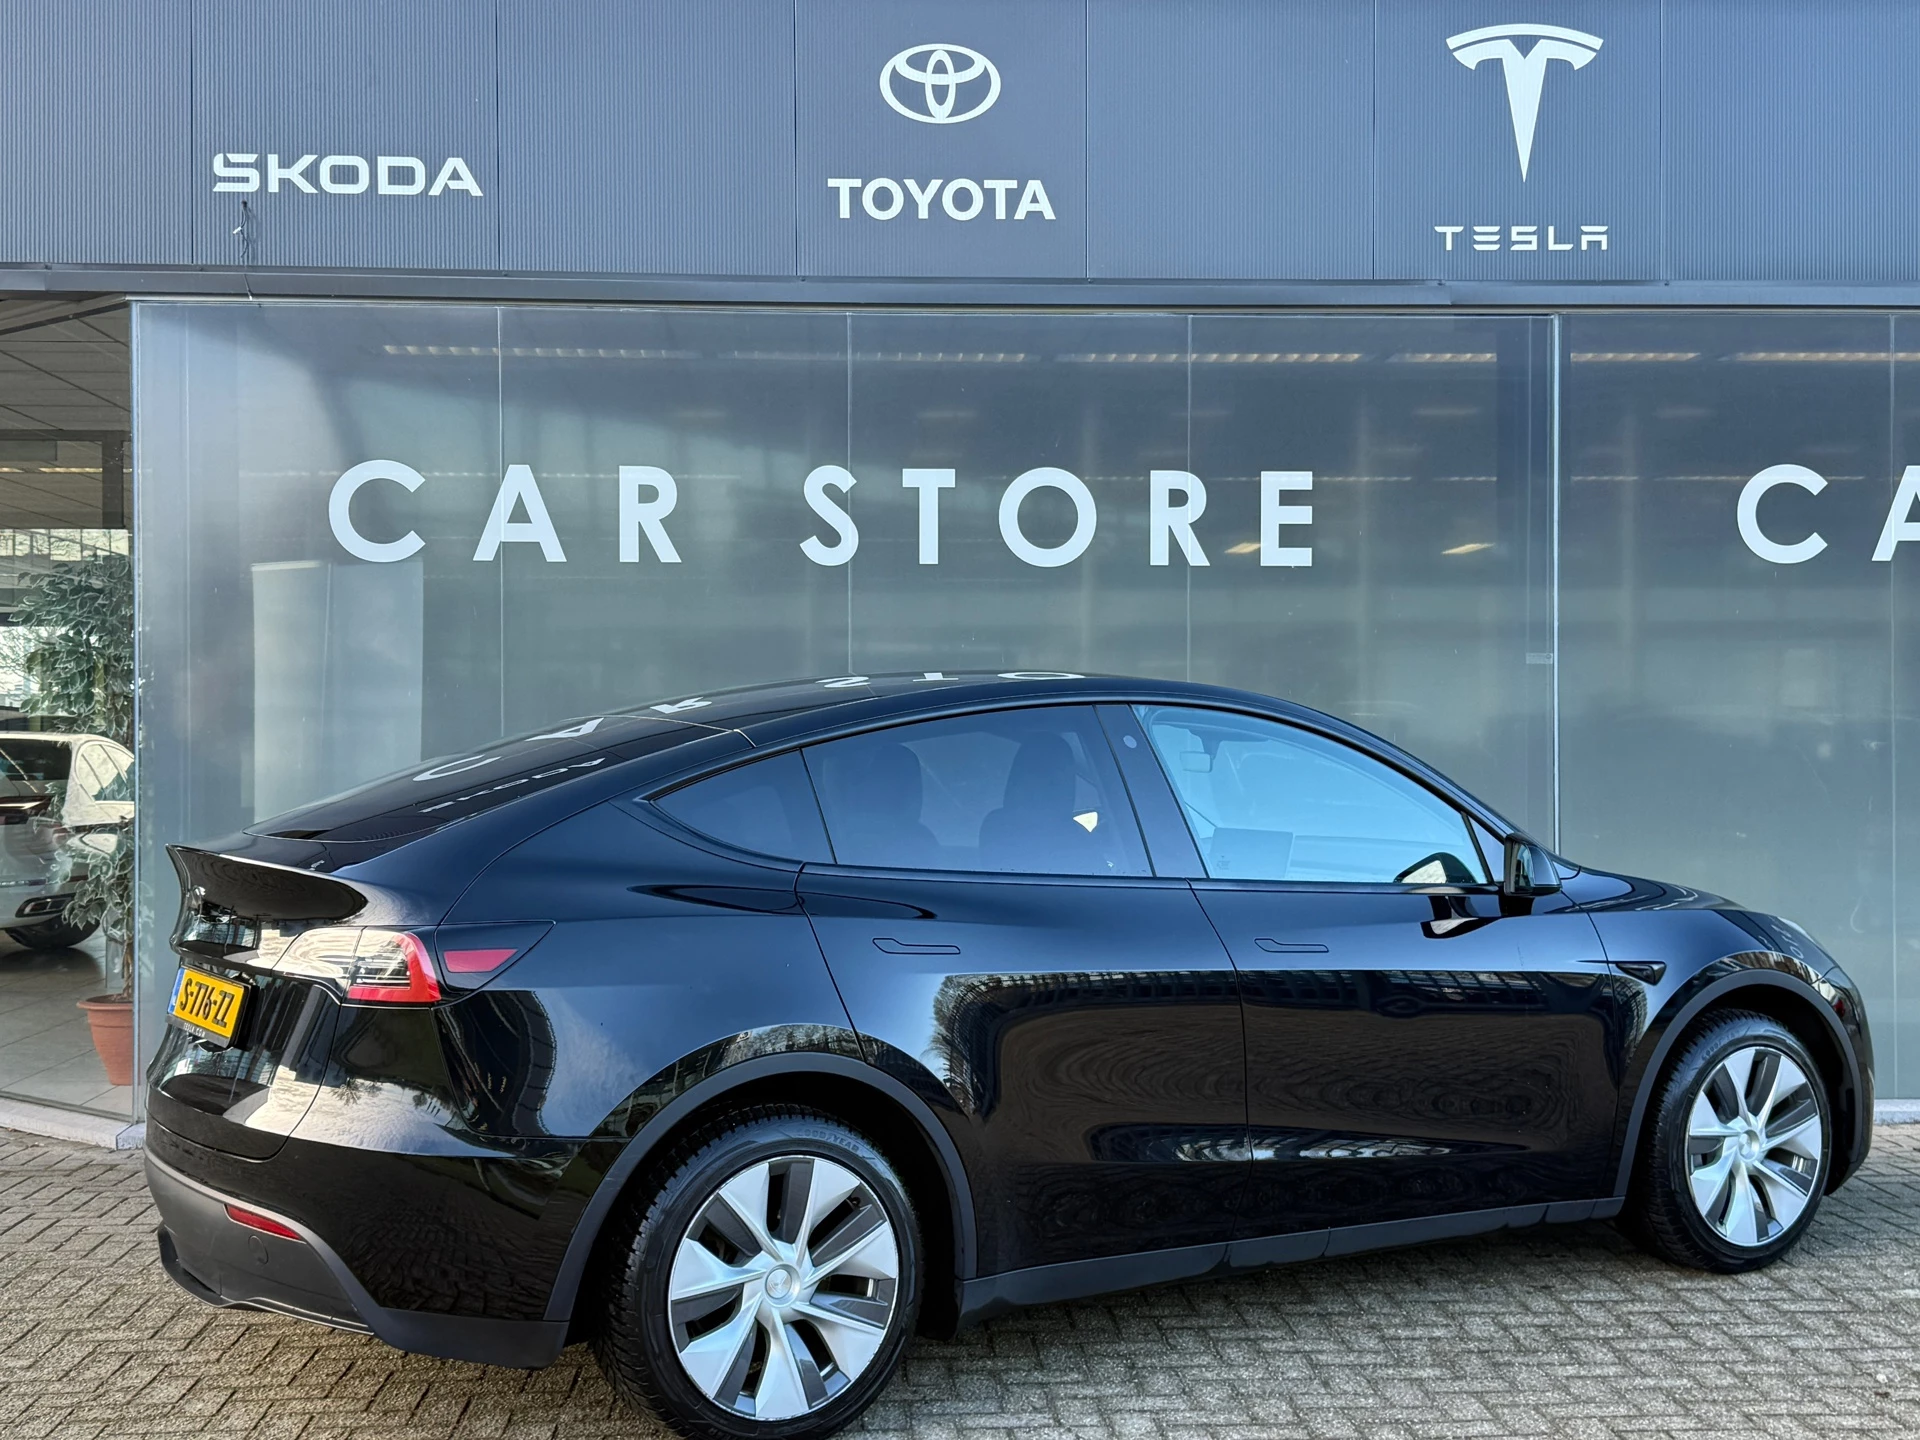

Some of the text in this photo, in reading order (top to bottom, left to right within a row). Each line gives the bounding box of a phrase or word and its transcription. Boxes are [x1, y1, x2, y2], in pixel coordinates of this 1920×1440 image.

[827, 177, 1057, 221] TOYOTA
[1434, 225, 1609, 251] TESLA
[328, 459, 1313, 568] CAR STORE
